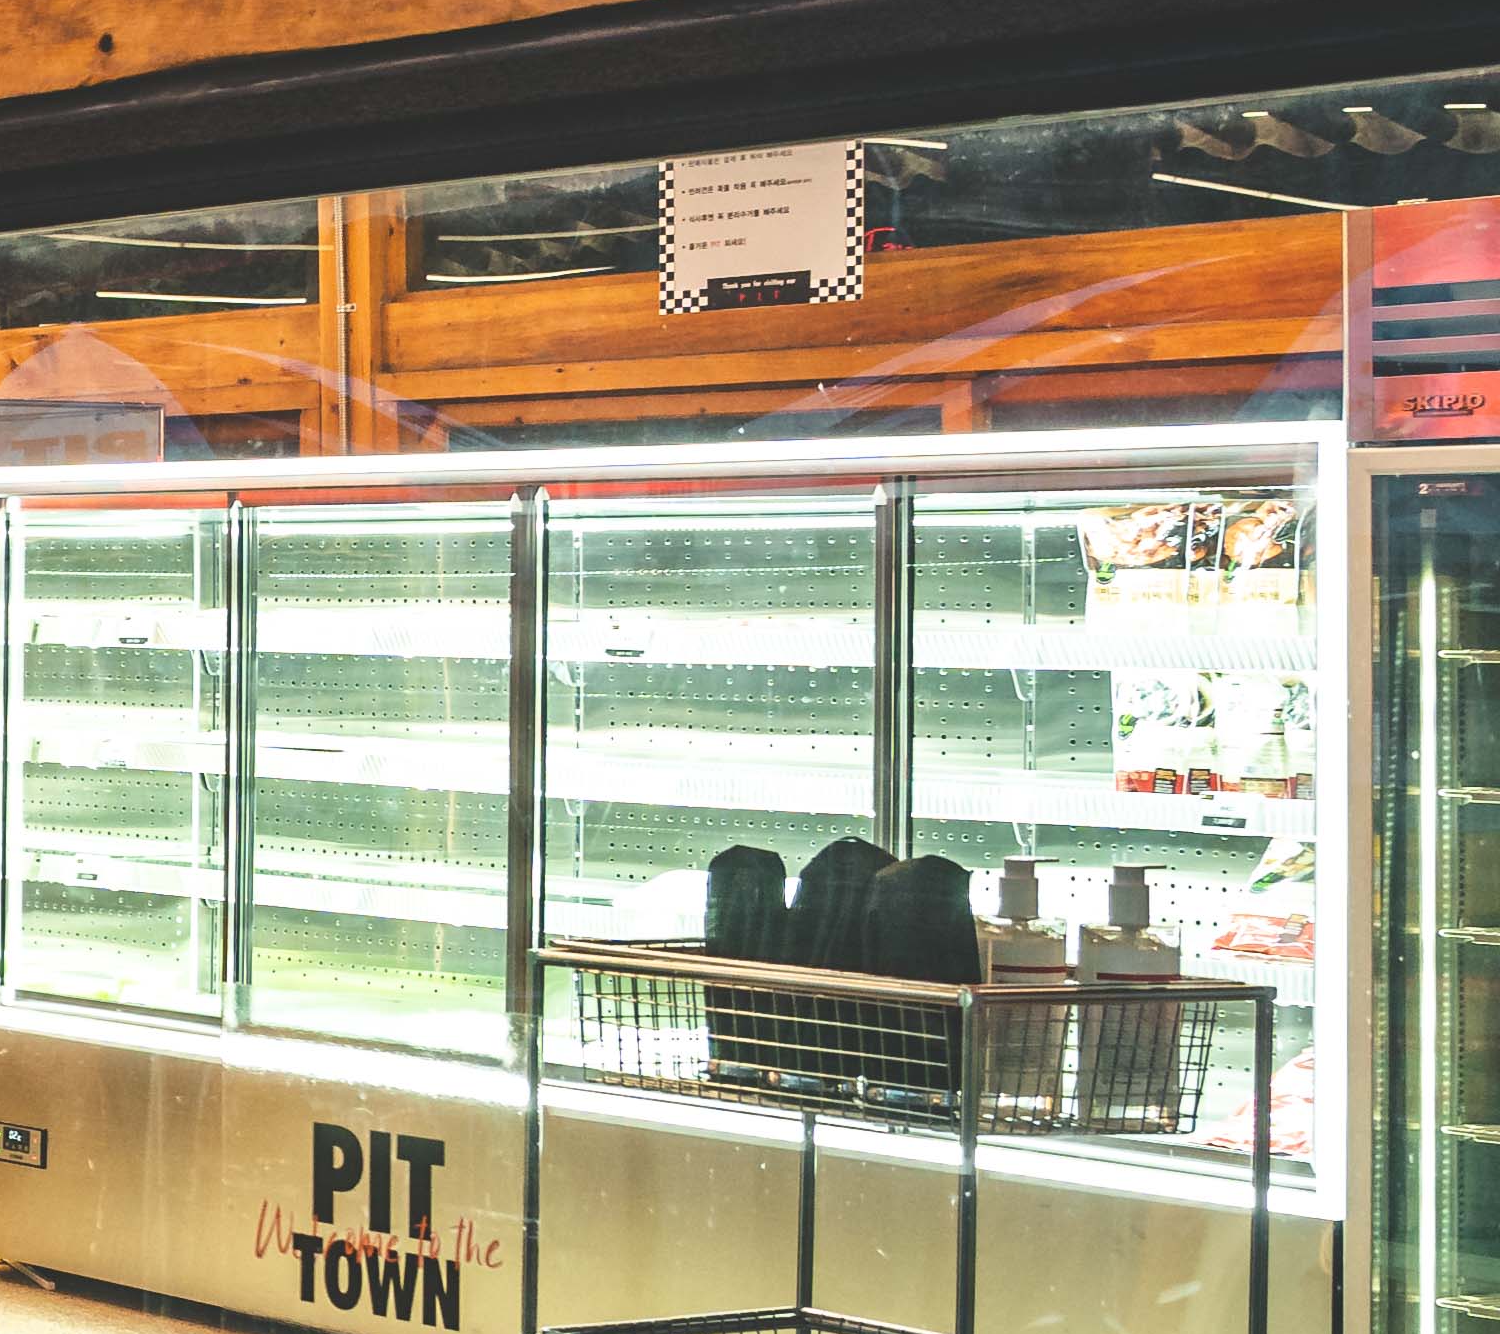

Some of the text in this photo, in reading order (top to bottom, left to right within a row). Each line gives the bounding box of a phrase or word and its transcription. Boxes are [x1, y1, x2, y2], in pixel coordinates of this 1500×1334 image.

[312, 1121, 445, 1241] PIT
[292, 1231, 460, 1332] TOWN
[414, 1214, 442, 1270] to
[450, 1215, 503, 1271] the
